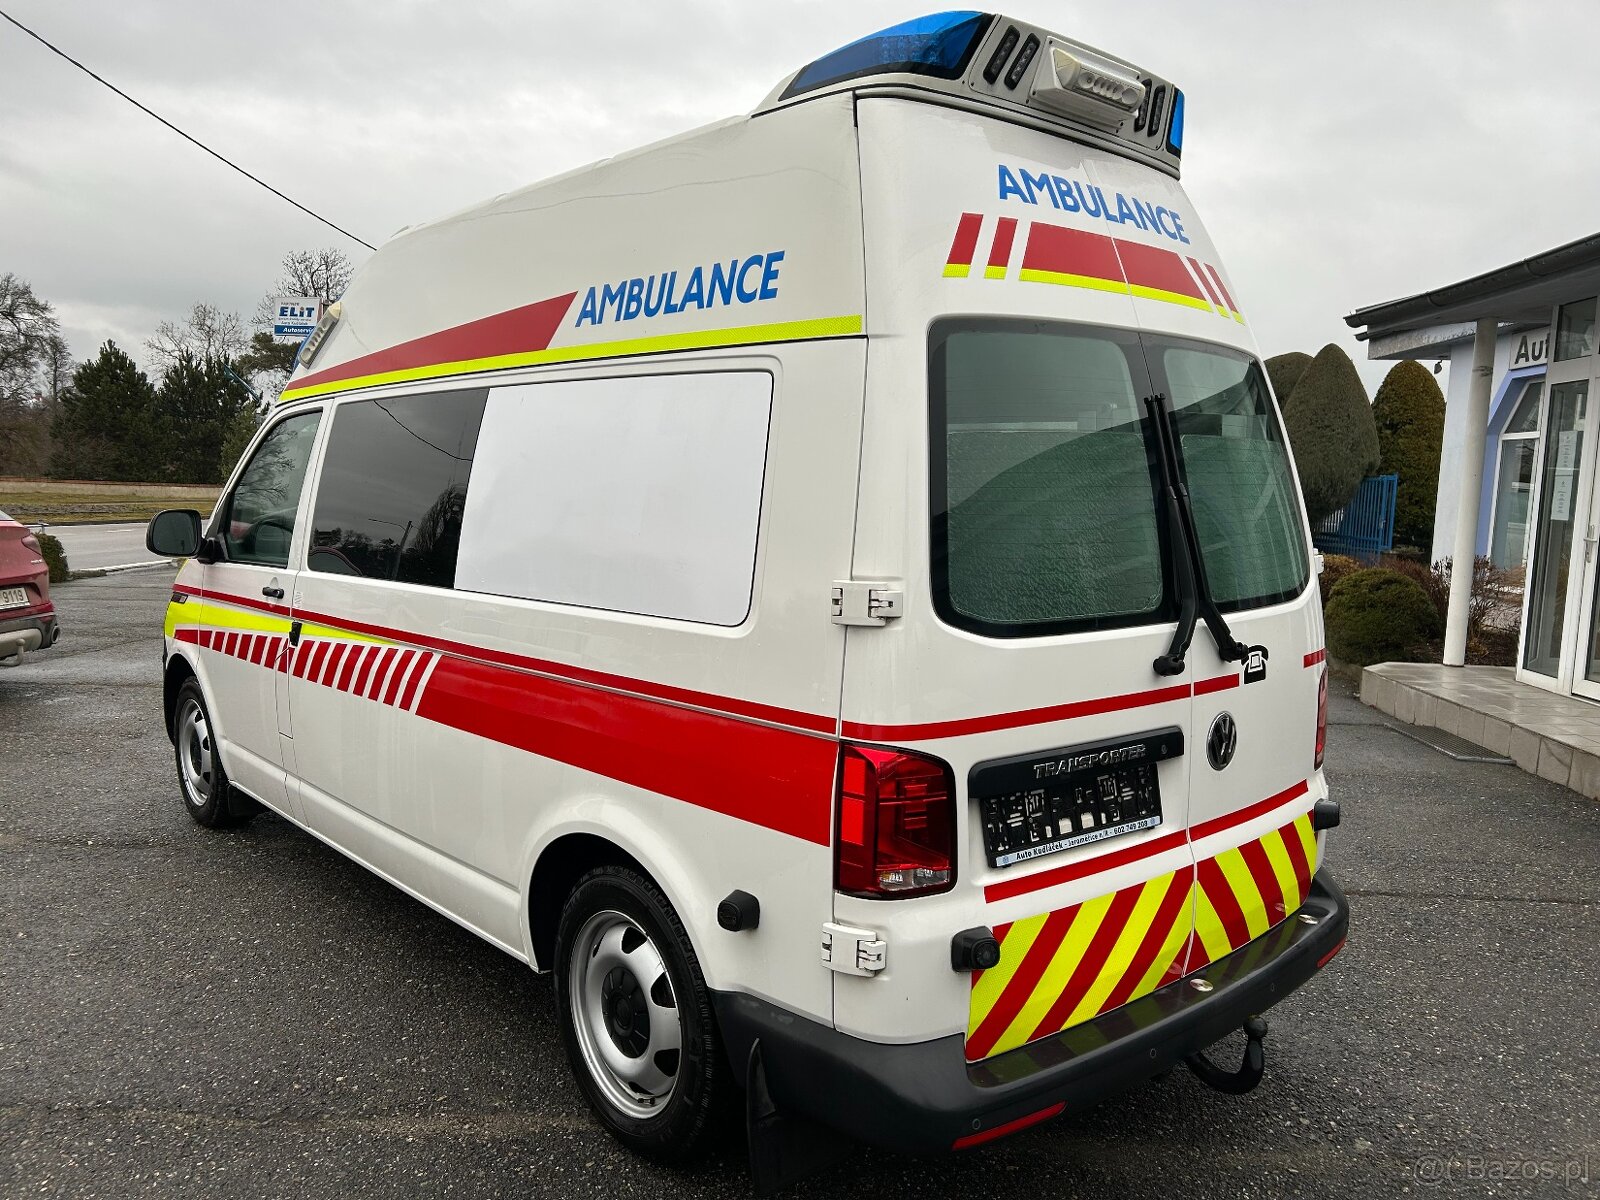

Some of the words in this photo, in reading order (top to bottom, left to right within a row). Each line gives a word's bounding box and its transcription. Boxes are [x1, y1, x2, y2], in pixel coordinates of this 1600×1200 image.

[998, 164, 1191, 245] AMBULANCE
[575, 250, 786, 328] AMBULANCE
[2, 589, 24, 603] 9119
[1033, 744, 1146, 779] TRANSPORTER
[1016, 850, 1032, 861] Auto
